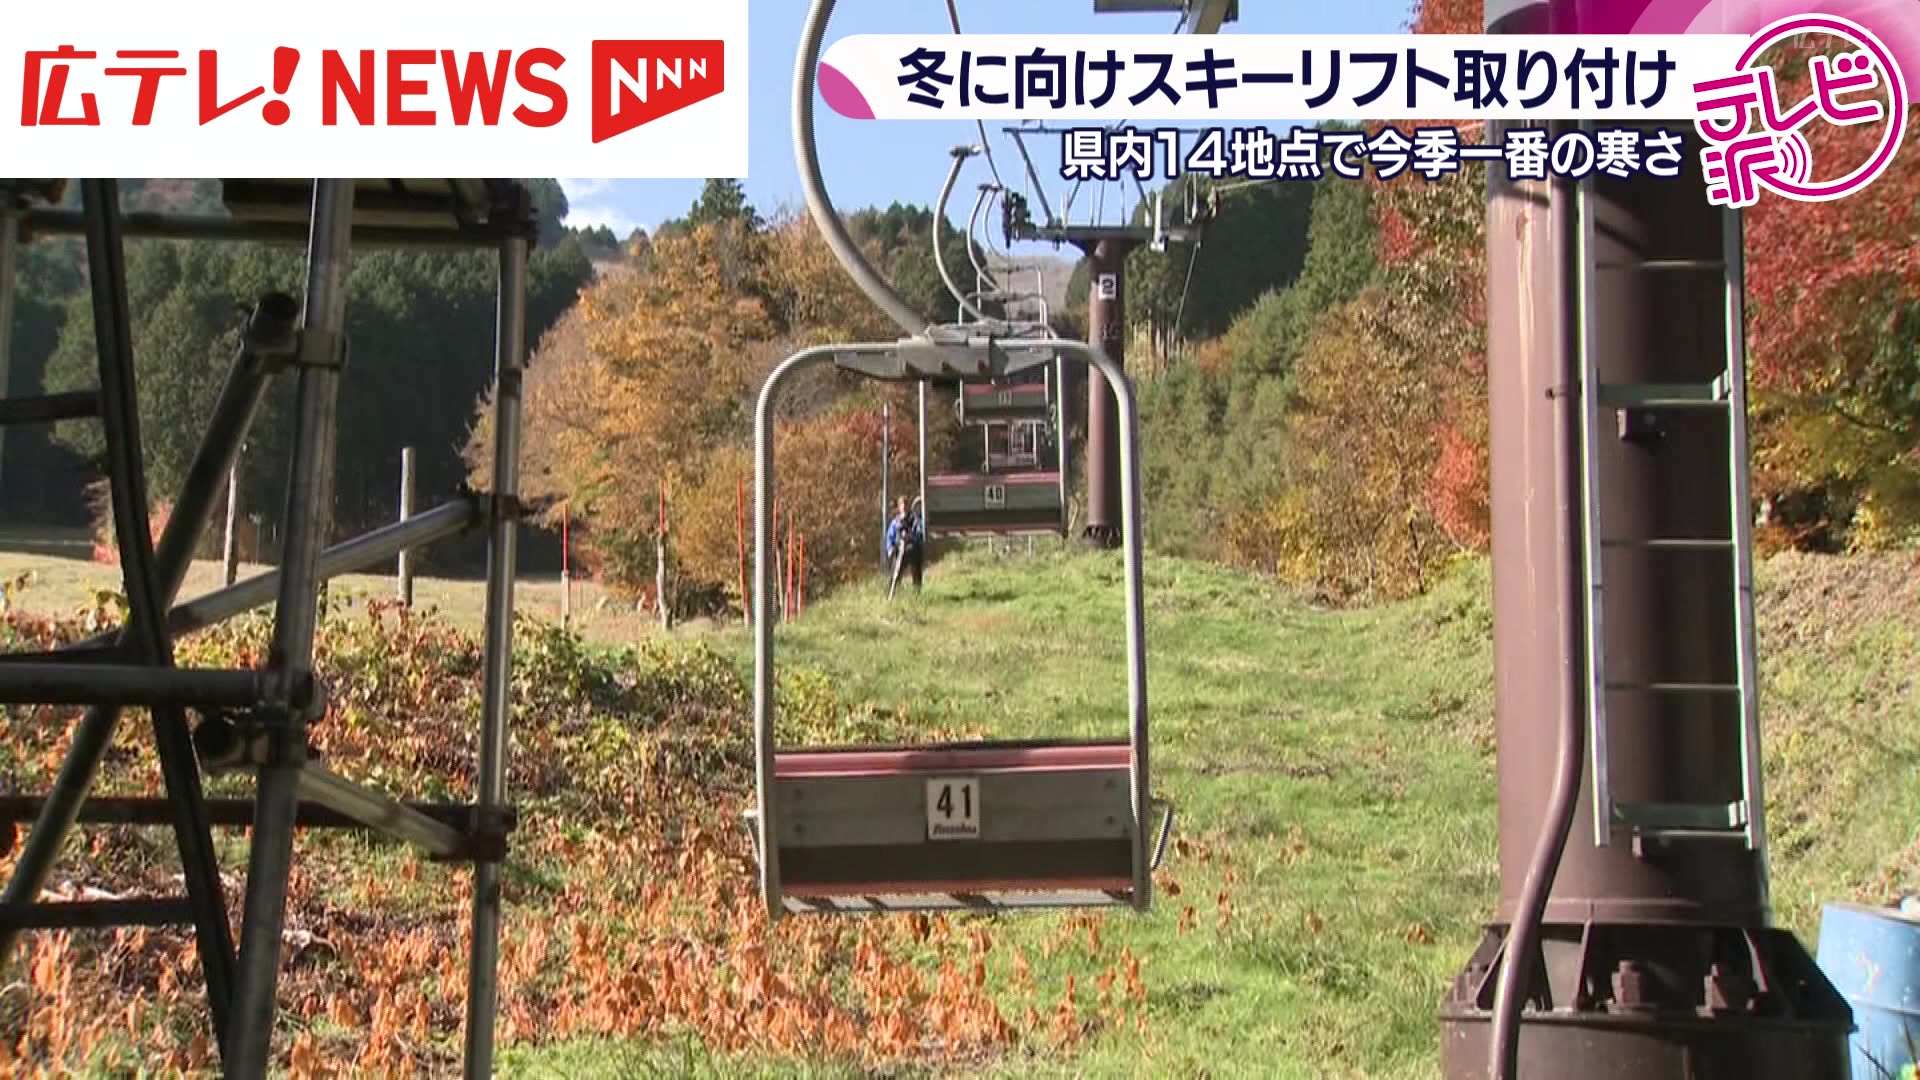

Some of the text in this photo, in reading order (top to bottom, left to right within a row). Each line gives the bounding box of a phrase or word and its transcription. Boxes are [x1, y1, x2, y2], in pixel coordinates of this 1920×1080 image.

[1102, 278, 1114, 295] 2
[986, 487, 1003, 501] 40
[936, 783, 972, 820] 41
